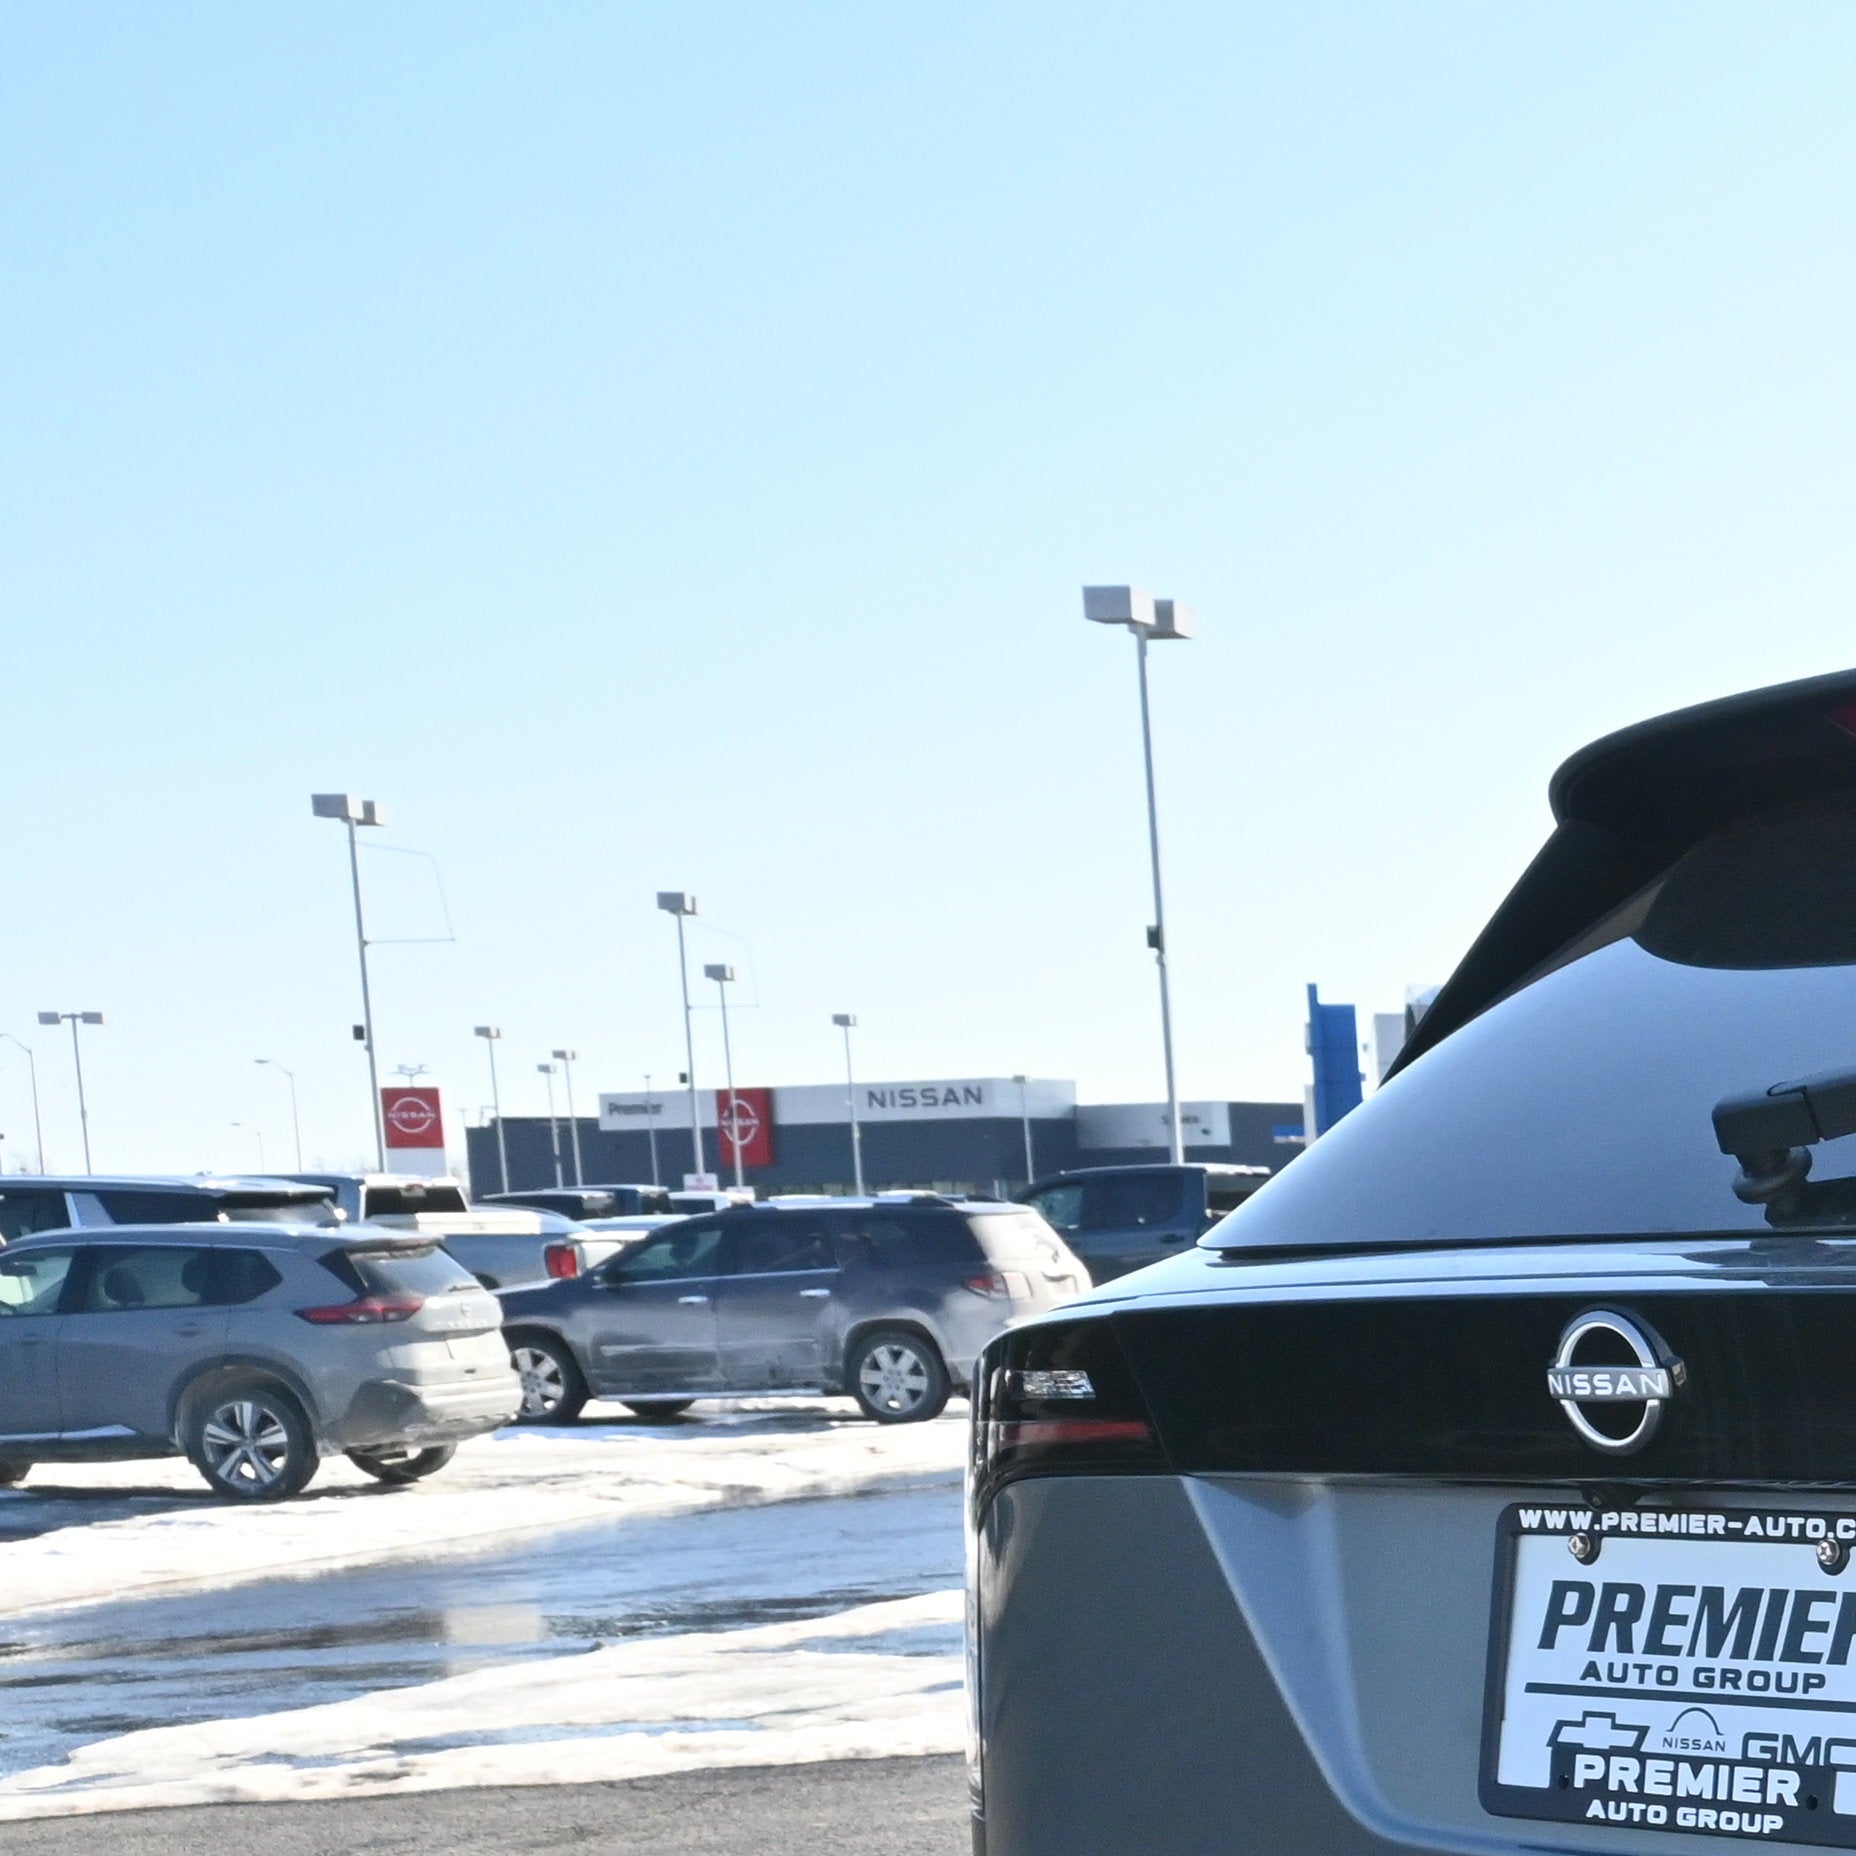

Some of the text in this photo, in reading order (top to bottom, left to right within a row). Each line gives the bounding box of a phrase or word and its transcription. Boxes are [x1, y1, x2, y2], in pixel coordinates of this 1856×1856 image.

[867, 1086, 983, 1108] NISSAN
[1549, 1373, 1664, 1396] NISSAN
[1579, 1660, 1827, 1695] AUTO GROUP
[1662, 1736, 1726, 1752] NISSAN
[1573, 1753, 1801, 1807] PREMIER
[1586, 1799, 1784, 1834] AUTO GROUP
